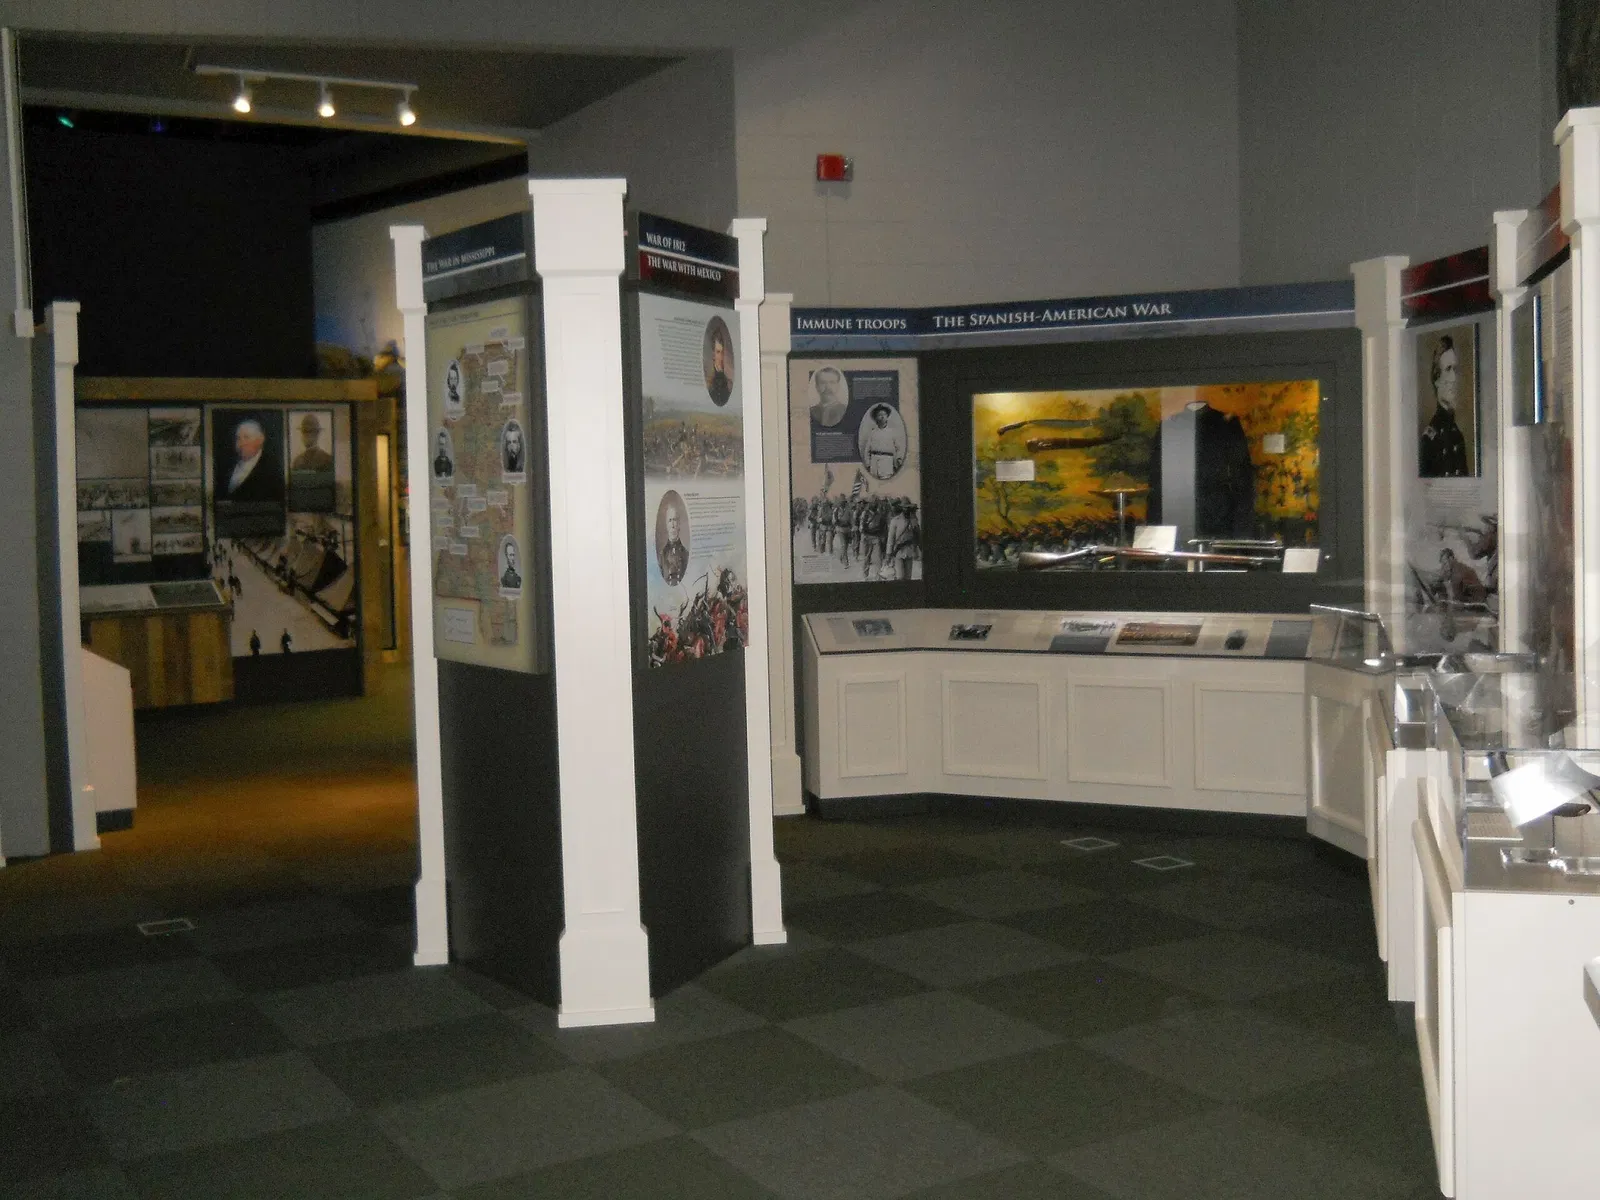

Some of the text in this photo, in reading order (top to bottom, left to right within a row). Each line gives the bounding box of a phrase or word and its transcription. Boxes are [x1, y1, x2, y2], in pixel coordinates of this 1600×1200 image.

[646, 232, 686, 252] WAR OF 1812
[647, 255, 721, 282] THE WAR WITH MEXICO
[796, 317, 907, 329] IMMUNE TROOPS
[932, 303, 1171, 328] THE SPANISH-AMERICAN WAR
